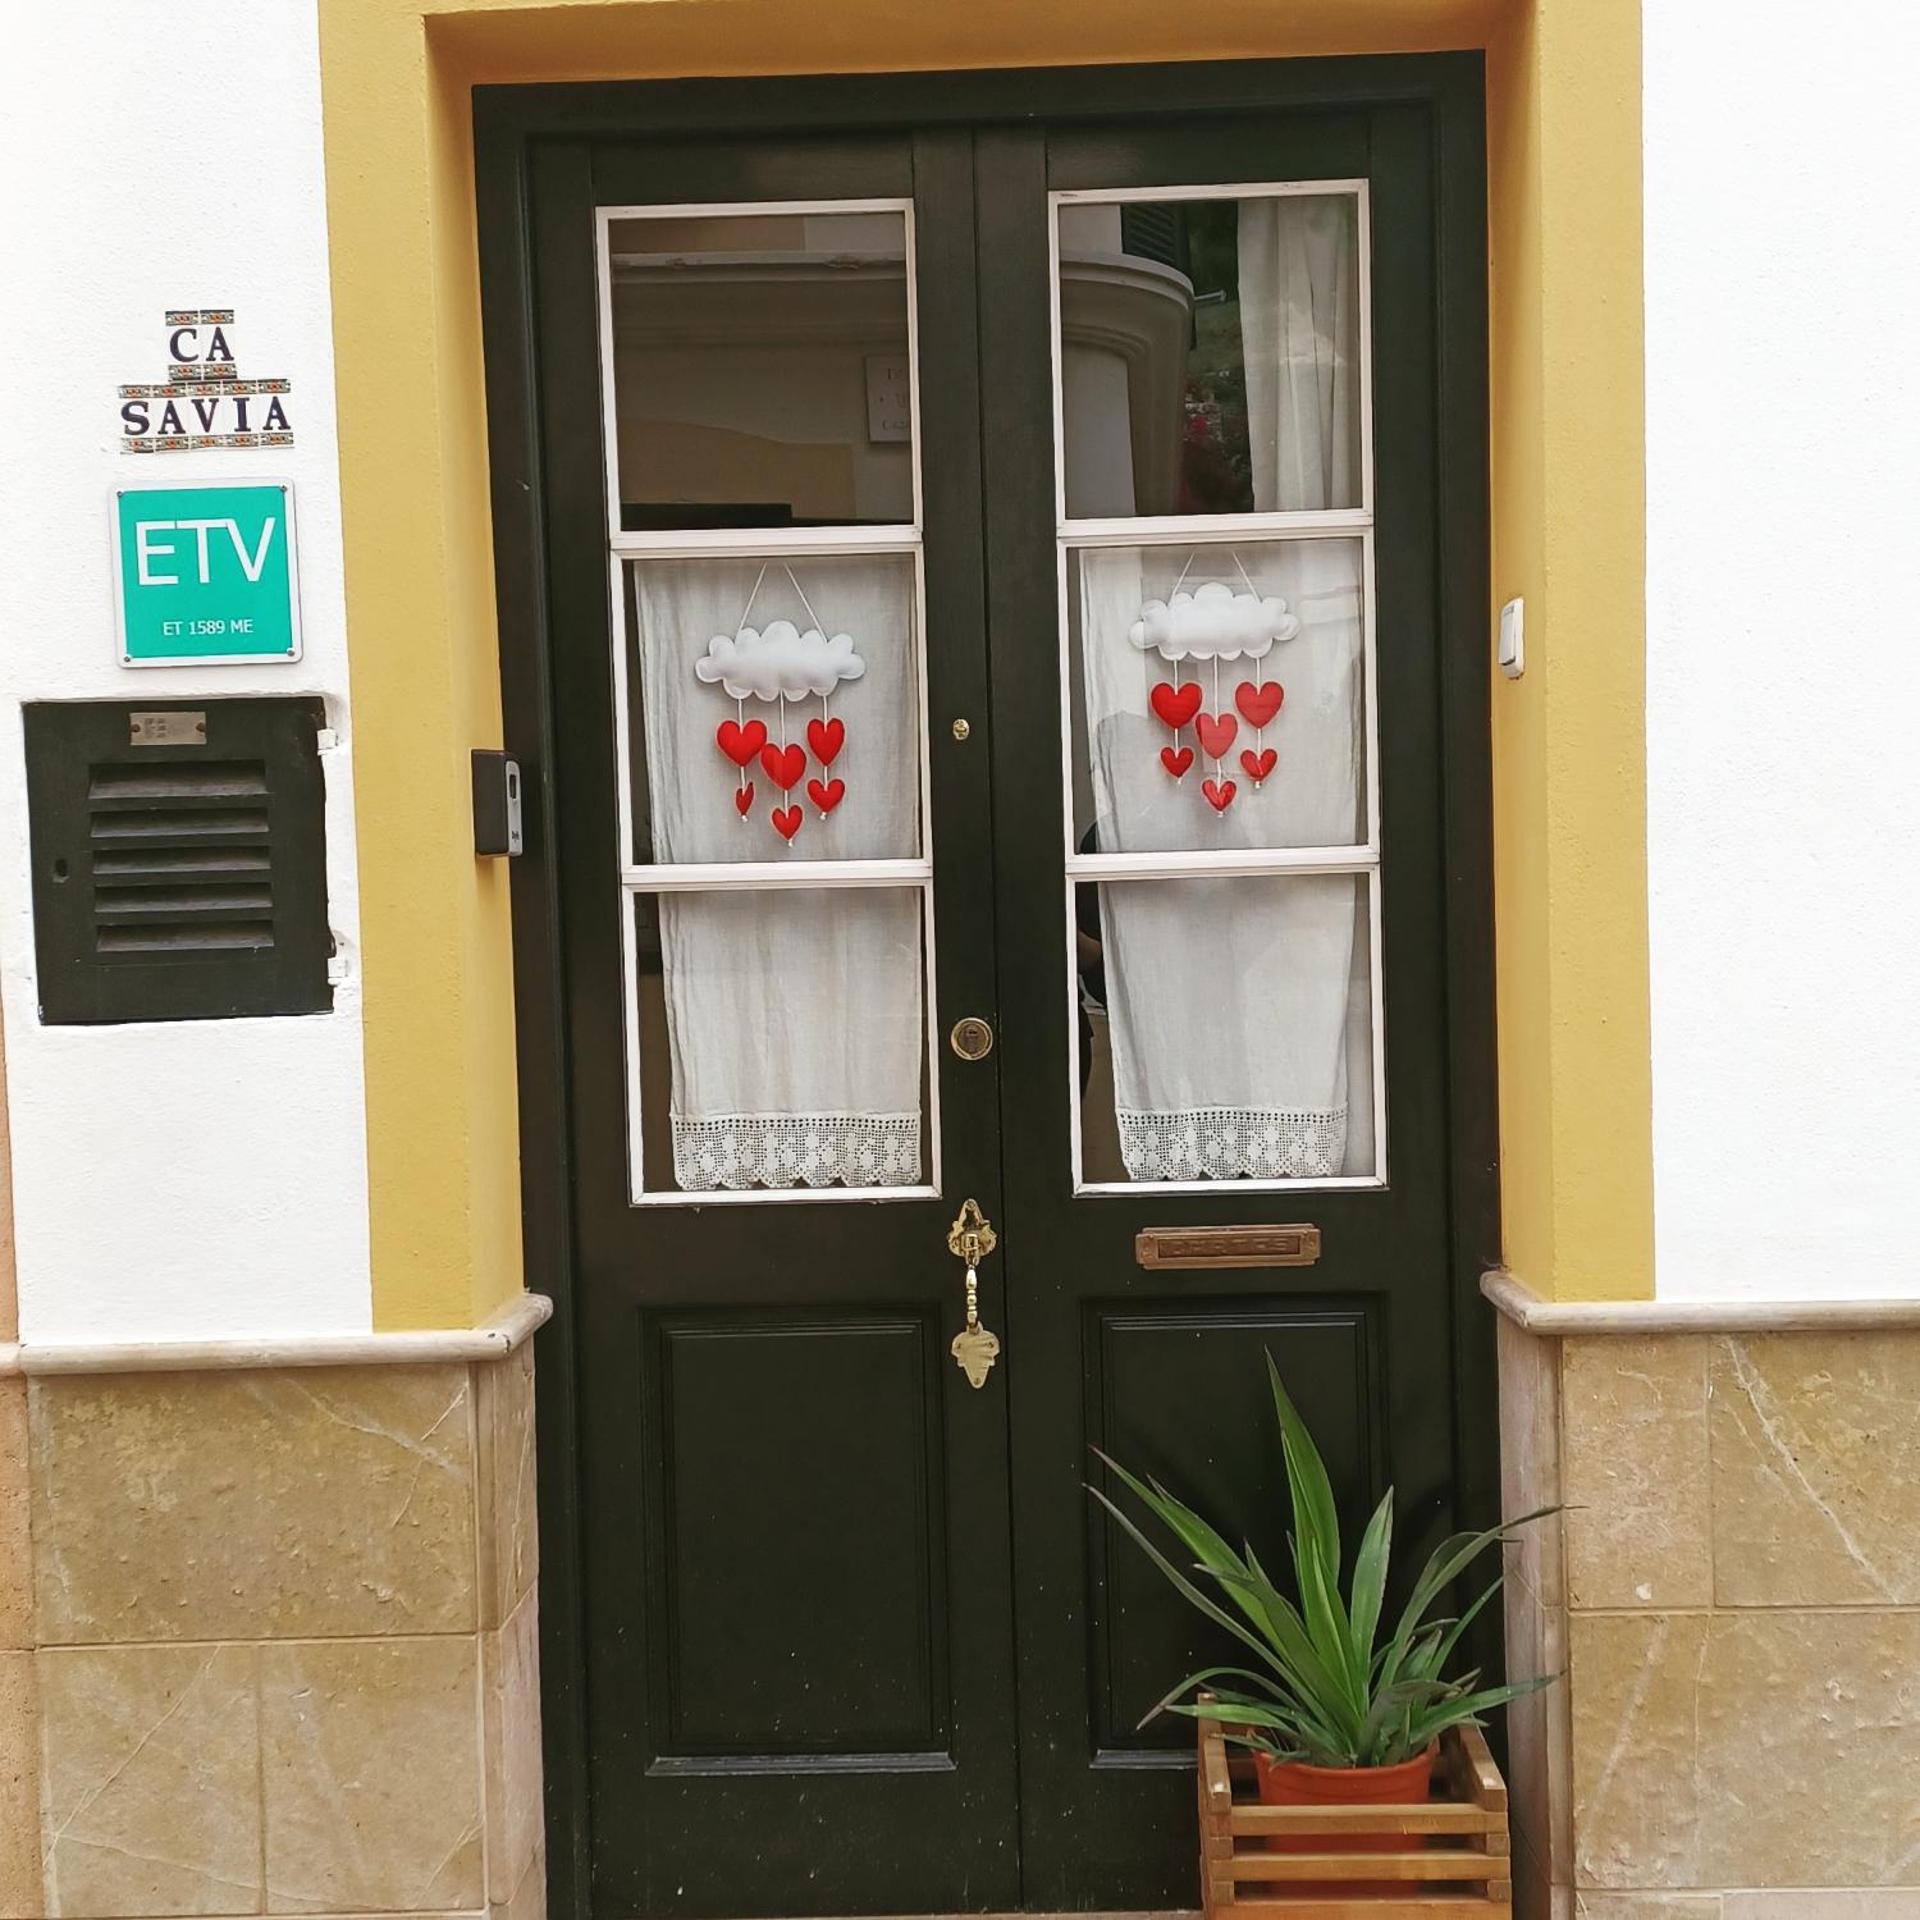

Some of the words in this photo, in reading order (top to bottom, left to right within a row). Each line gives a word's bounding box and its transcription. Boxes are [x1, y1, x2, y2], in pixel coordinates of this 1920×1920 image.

[169, 326, 234, 362] CA
[121, 396, 291, 435] SAVIA
[135, 517, 276, 585] ETV
[163, 621, 185, 636] ET
[189, 620, 225, 635] 1589
[231, 619, 253, 634] ME
